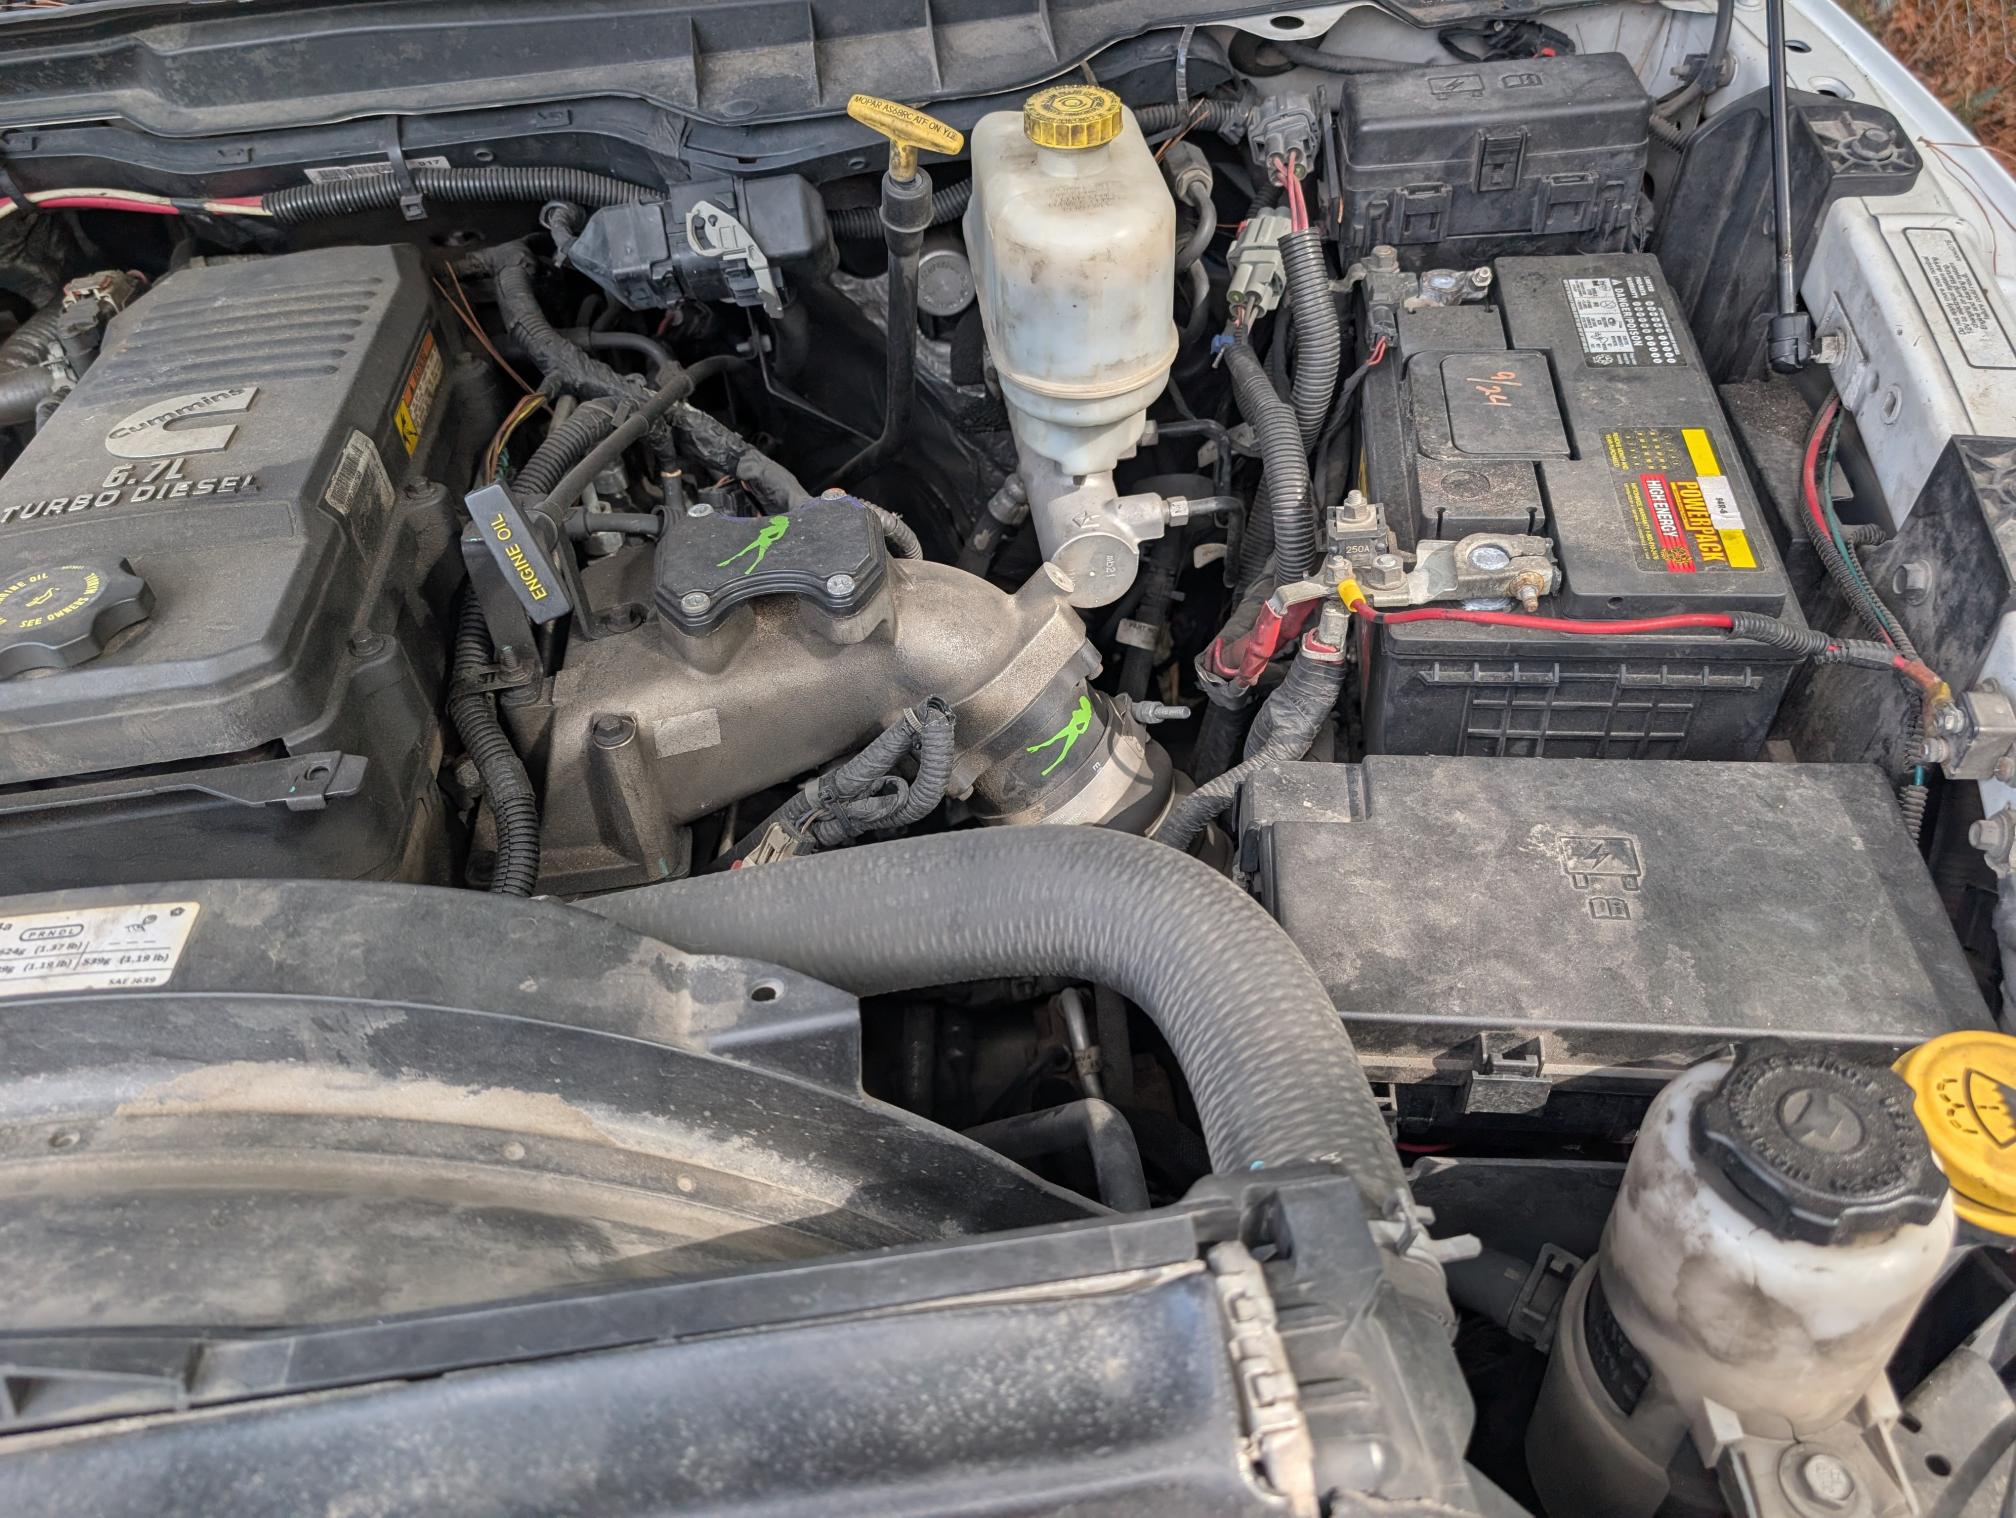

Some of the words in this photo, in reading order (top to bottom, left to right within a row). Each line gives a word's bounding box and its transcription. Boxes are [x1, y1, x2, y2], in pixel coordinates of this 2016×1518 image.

[855, 96, 882, 109] MOPAR
[912, 115, 928, 126] ATF
[1614, 288, 1643, 346] DANGER/POISON
[108, 387, 245, 440] Cummins
[102, 457, 186, 488] 6.7L
[1646, 480, 1666, 499] HIGH
[0, 489, 121, 524] TURBO
[1653, 503, 1679, 537] ENERGY
[1677, 481, 1726, 561] POWERPACK
[491, 514, 511, 541] OIL
[1345, 545, 1370, 554] 250A
[29, 573, 48, 583] OIL
[505, 544, 548, 600] ENGINE
[19, 617, 43, 628] SEE
[153, 952, 169, 963] lb)
